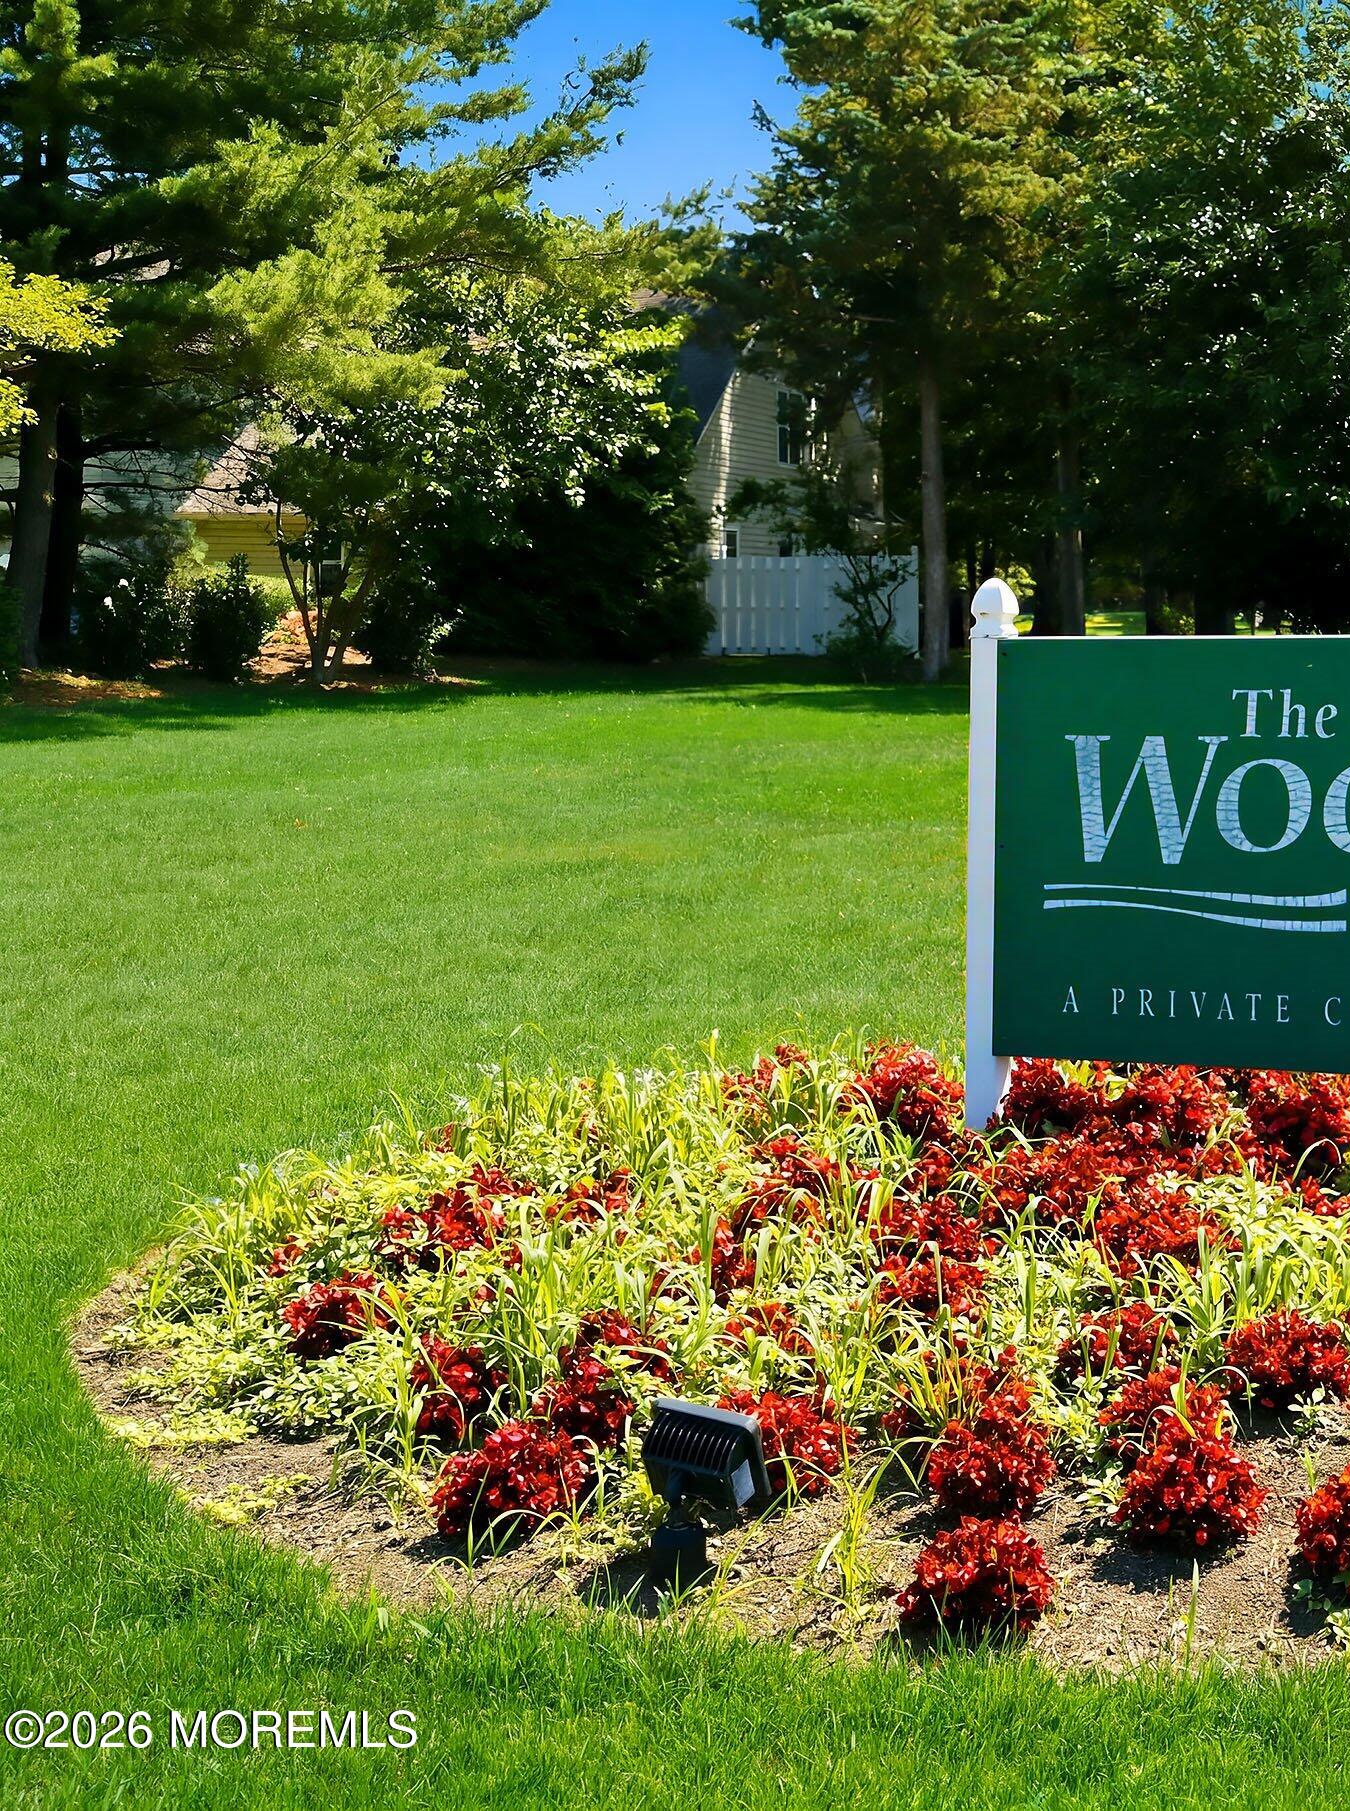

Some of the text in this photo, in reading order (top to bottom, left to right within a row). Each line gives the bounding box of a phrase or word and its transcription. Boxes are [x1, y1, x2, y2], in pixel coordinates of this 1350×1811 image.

[1233, 689, 1337, 738] The
[1063, 987, 1078, 1012] A
[1113, 989, 1289, 1022] PRIVATE
